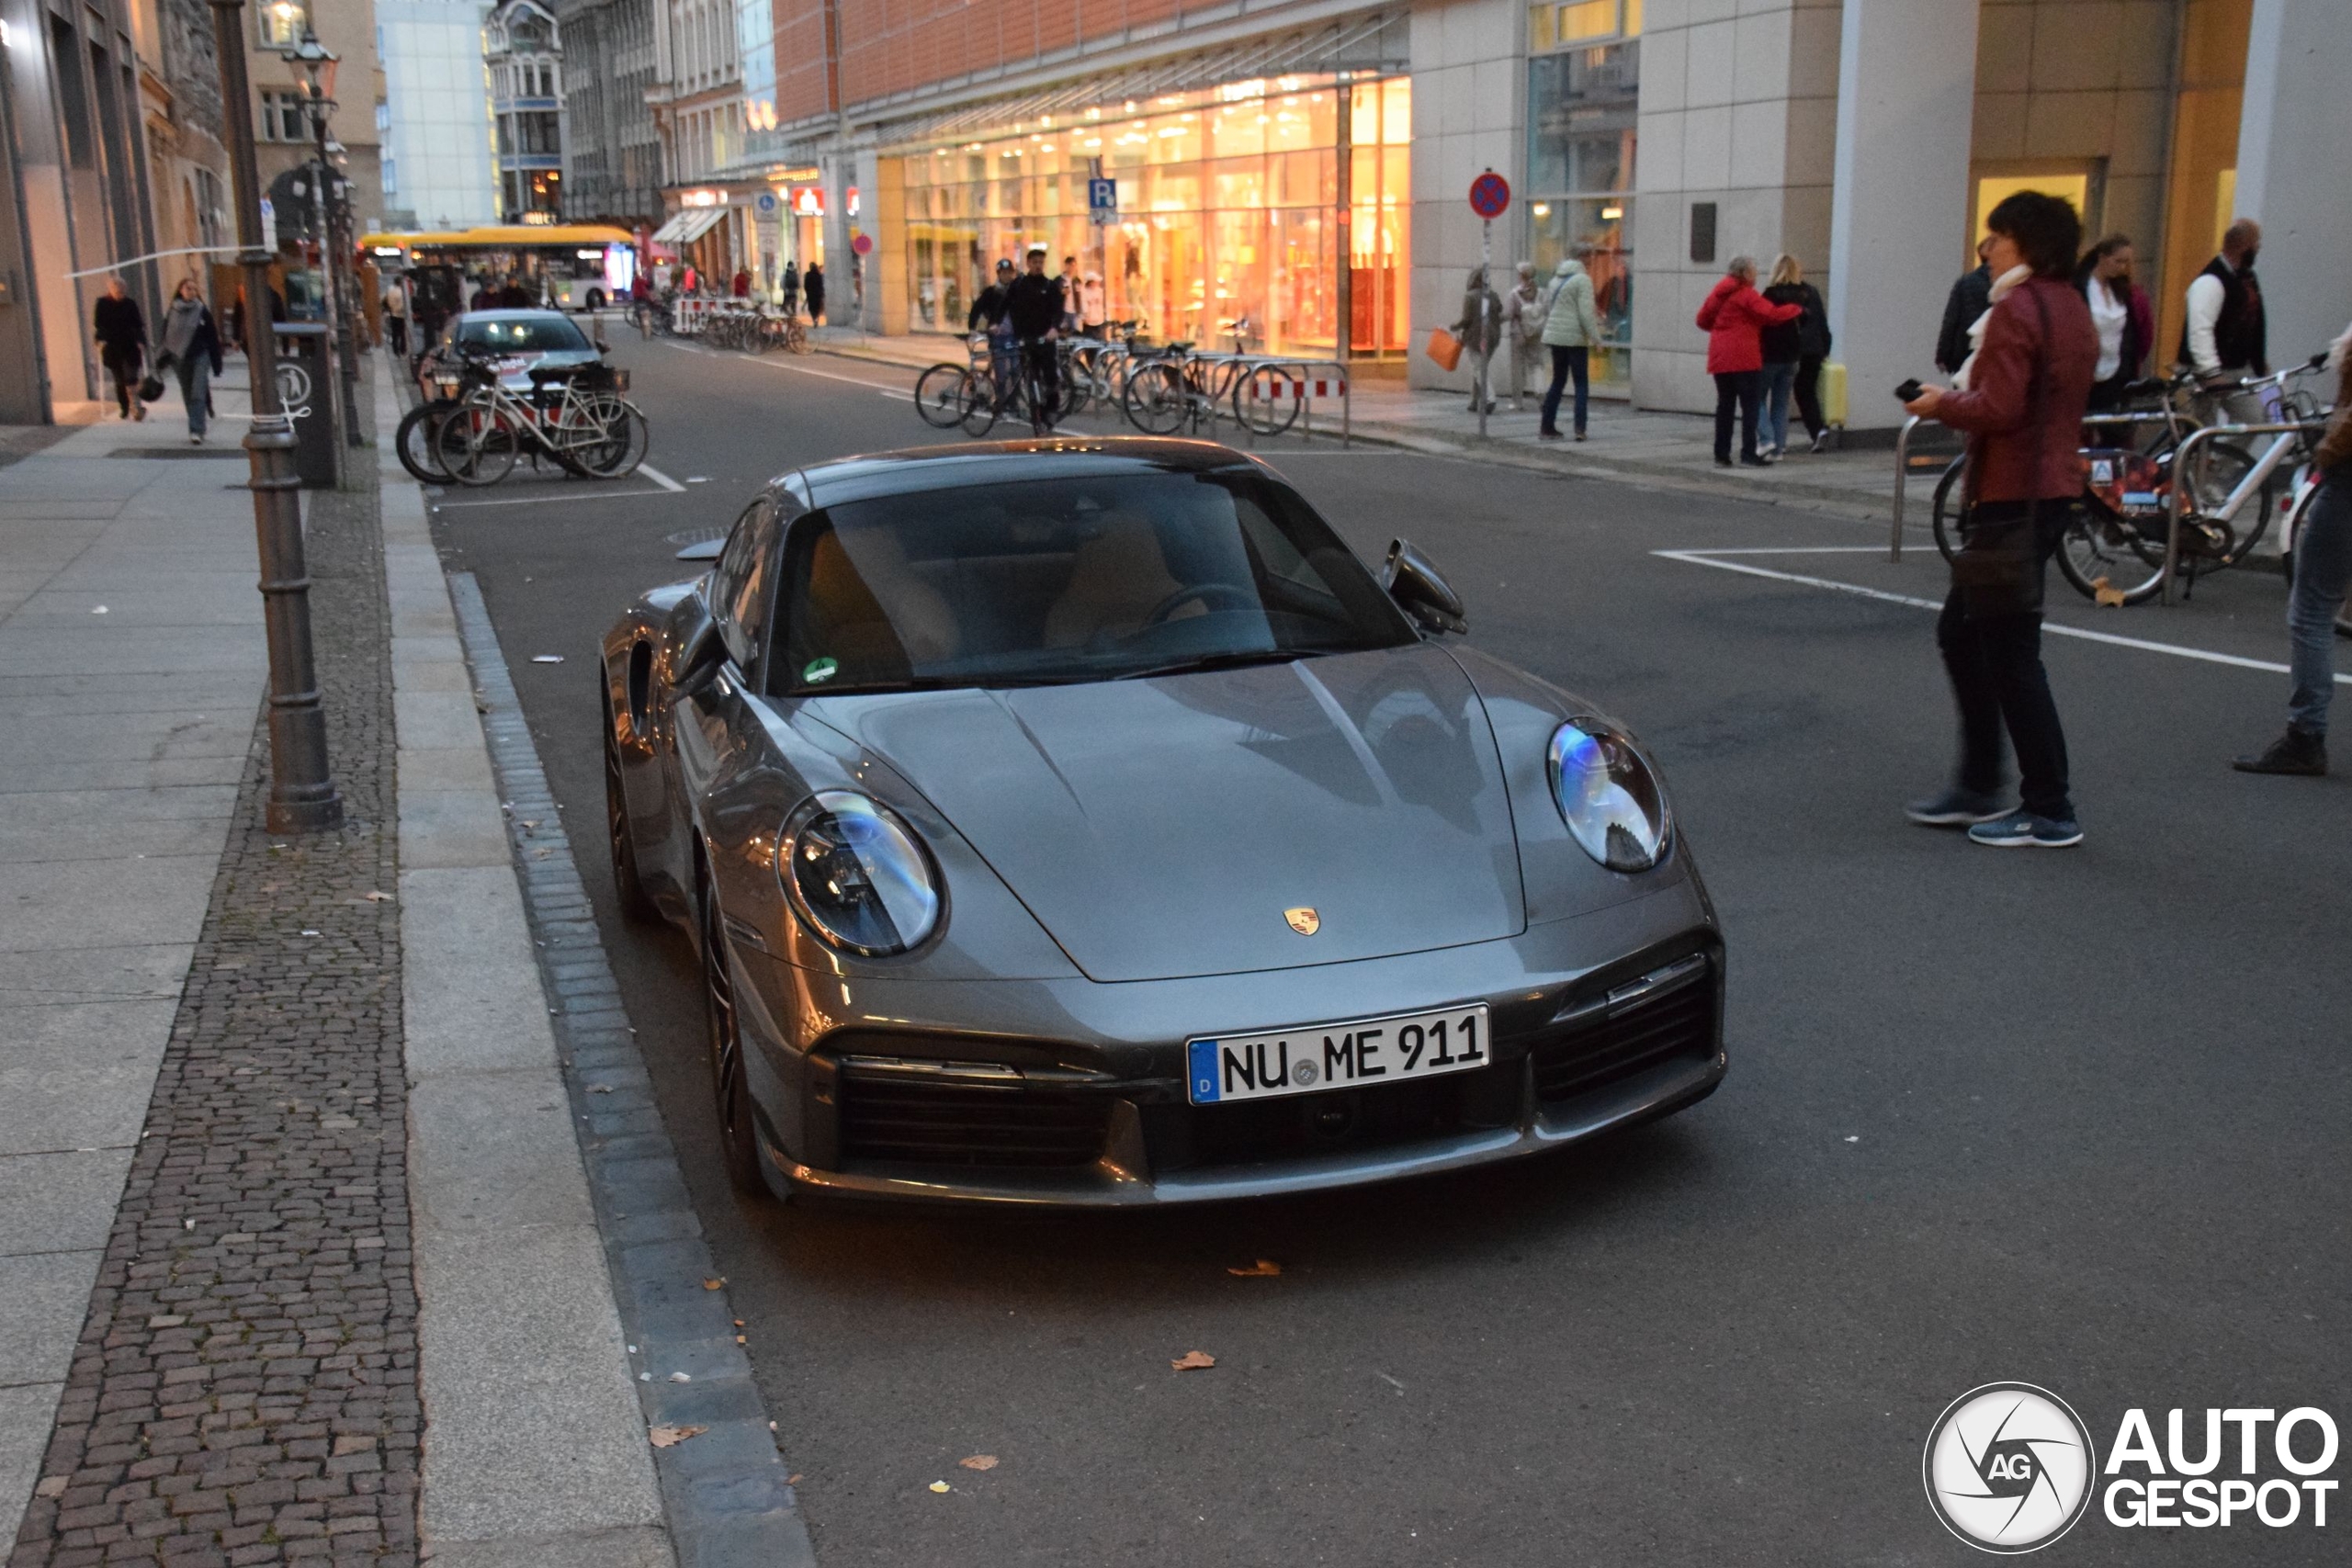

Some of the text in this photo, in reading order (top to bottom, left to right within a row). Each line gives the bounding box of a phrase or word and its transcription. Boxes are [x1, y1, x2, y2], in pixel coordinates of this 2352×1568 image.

[1223, 1041, 1288, 1093] NU
[1323, 1030, 1386, 1081] ME
[1398, 1015, 1484, 1071] 911
[1201, 1078, 1211, 1093] D
